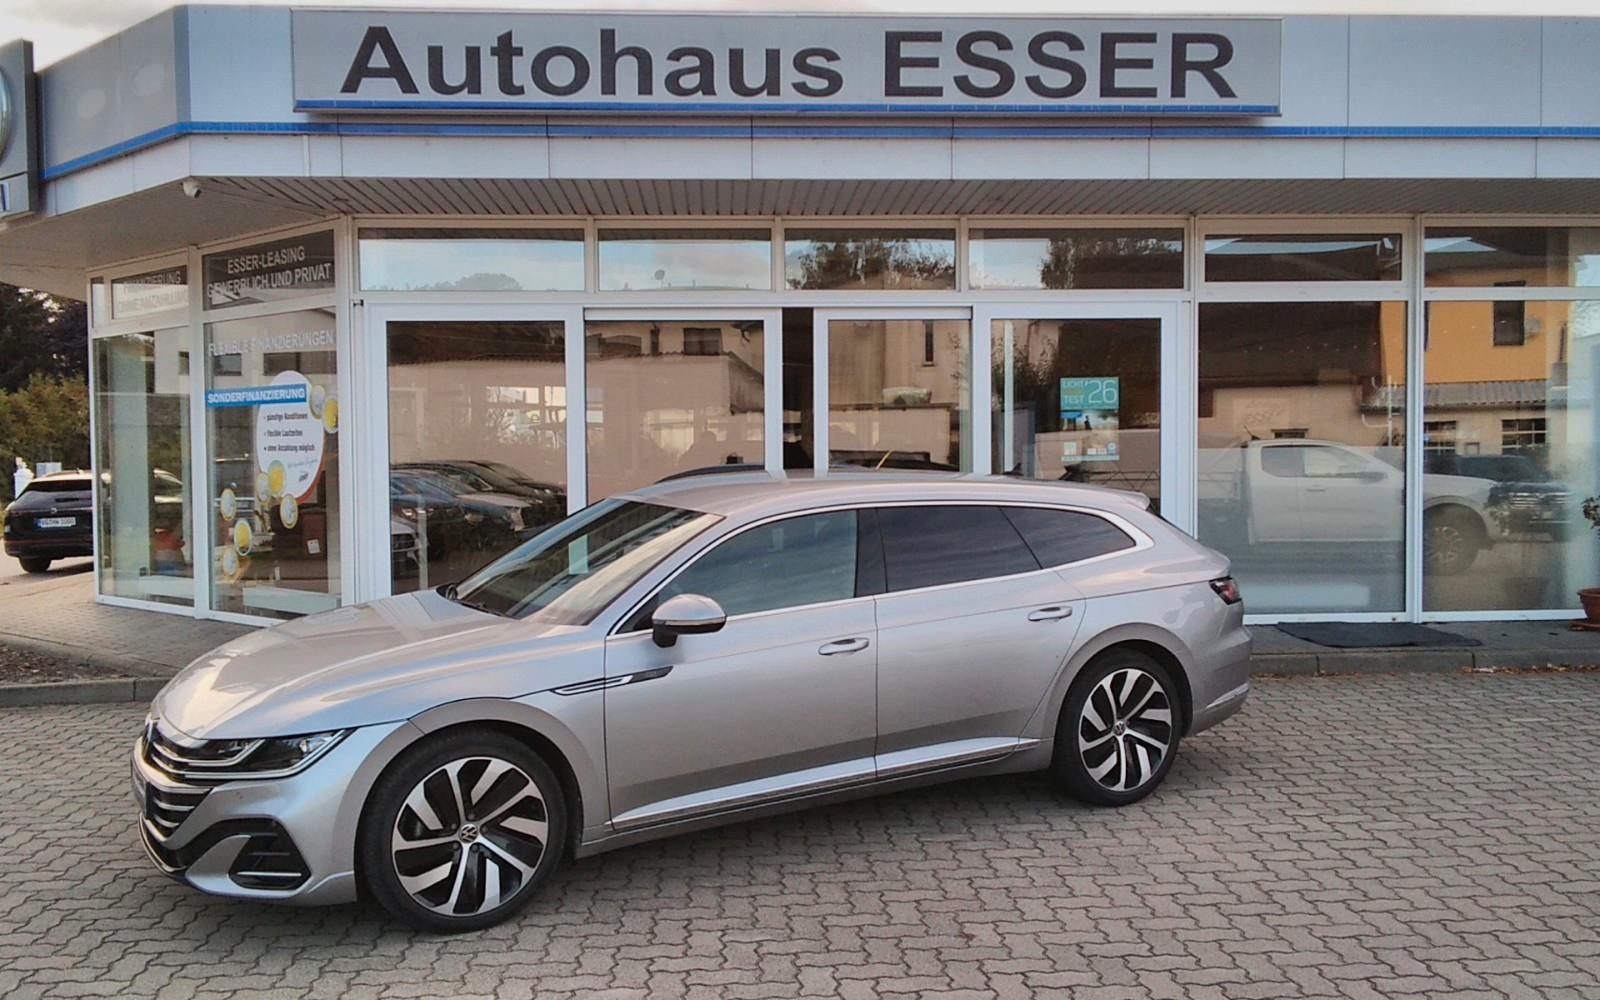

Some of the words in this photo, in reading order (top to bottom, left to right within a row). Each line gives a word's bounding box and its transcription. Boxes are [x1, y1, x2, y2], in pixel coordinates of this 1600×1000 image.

[340, 26, 844, 96] Autohaus
[884, 30, 1238, 98] ESSER
[227, 246, 305, 274] ESSER-LEASING
[270, 270, 292, 288] UND
[294, 262, 331, 284] PRIVAT
[207, 388, 305, 403] SONDERFINANZIERUNG
